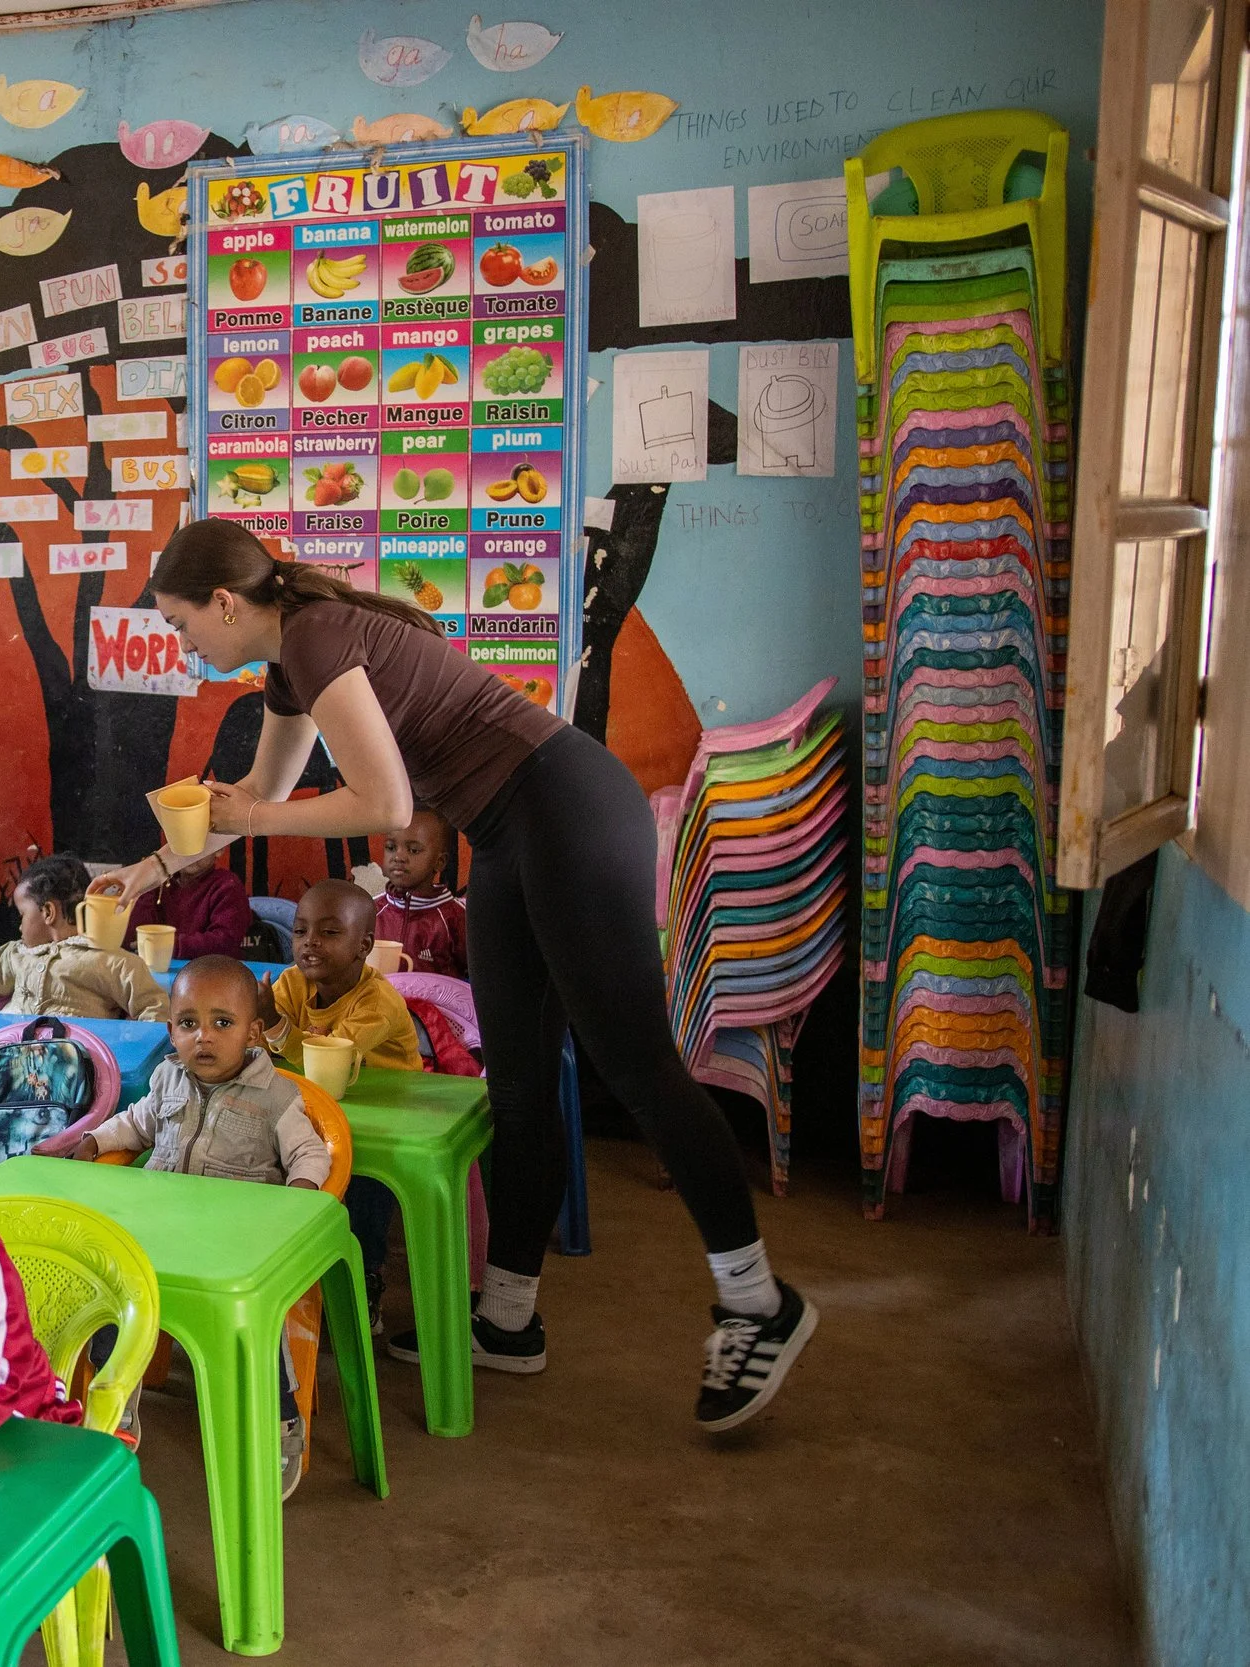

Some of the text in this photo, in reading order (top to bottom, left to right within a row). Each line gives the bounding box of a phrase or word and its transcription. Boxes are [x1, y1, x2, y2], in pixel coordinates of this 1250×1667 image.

[669, 109, 747, 143] THINGS
[767, 98, 825, 127] USED
[829, 90, 859, 114] TO
[887, 83, 989, 114] CLEAN
[270, 164, 497, 216] FRUIT
[384, 218, 469, 238] watermelon
[485, 213, 555, 231] tomato
[222, 230, 274, 251] apple
[302, 224, 370, 243] banana
[47, 269, 117, 315] FUN
[302, 305, 372, 323] Banane
[383, 299, 468, 319] Pastèque
[485, 296, 557, 314] Tomate
[215, 310, 282, 328] Pomme
[307, 331, 364, 351] peach
[392, 328, 458, 349] mango
[483, 323, 553, 344] grapes
[42, 334, 95, 365] BUG
[223, 337, 278, 353] lemon
[10, 380, 80, 422] SIX
[221, 414, 277, 429] Citron
[302, 410, 368, 427] Pêcher
[386, 407, 463, 426] Mangue
[486, 404, 549, 421] Raisin
[209, 437, 288, 454] carambola
[294, 435, 376, 454] strawberry
[402, 434, 446, 452] pear
[492, 430, 541, 447] plum
[21, 450, 70, 474] OR
[121, 458, 177, 489] BUS
[84, 502, 139, 525] BAT
[306, 513, 363, 530] Fraise
[397, 512, 449, 529] Poire
[486, 511, 545, 527] Prune
[304, 537, 365, 557] cherry
[381, 536, 464, 556] pineapple
[484, 538, 547, 556] orange
[56, 547, 115, 570] MOP
[471, 617, 556, 633] Mandarin
[471, 644, 557, 661] persimmon
